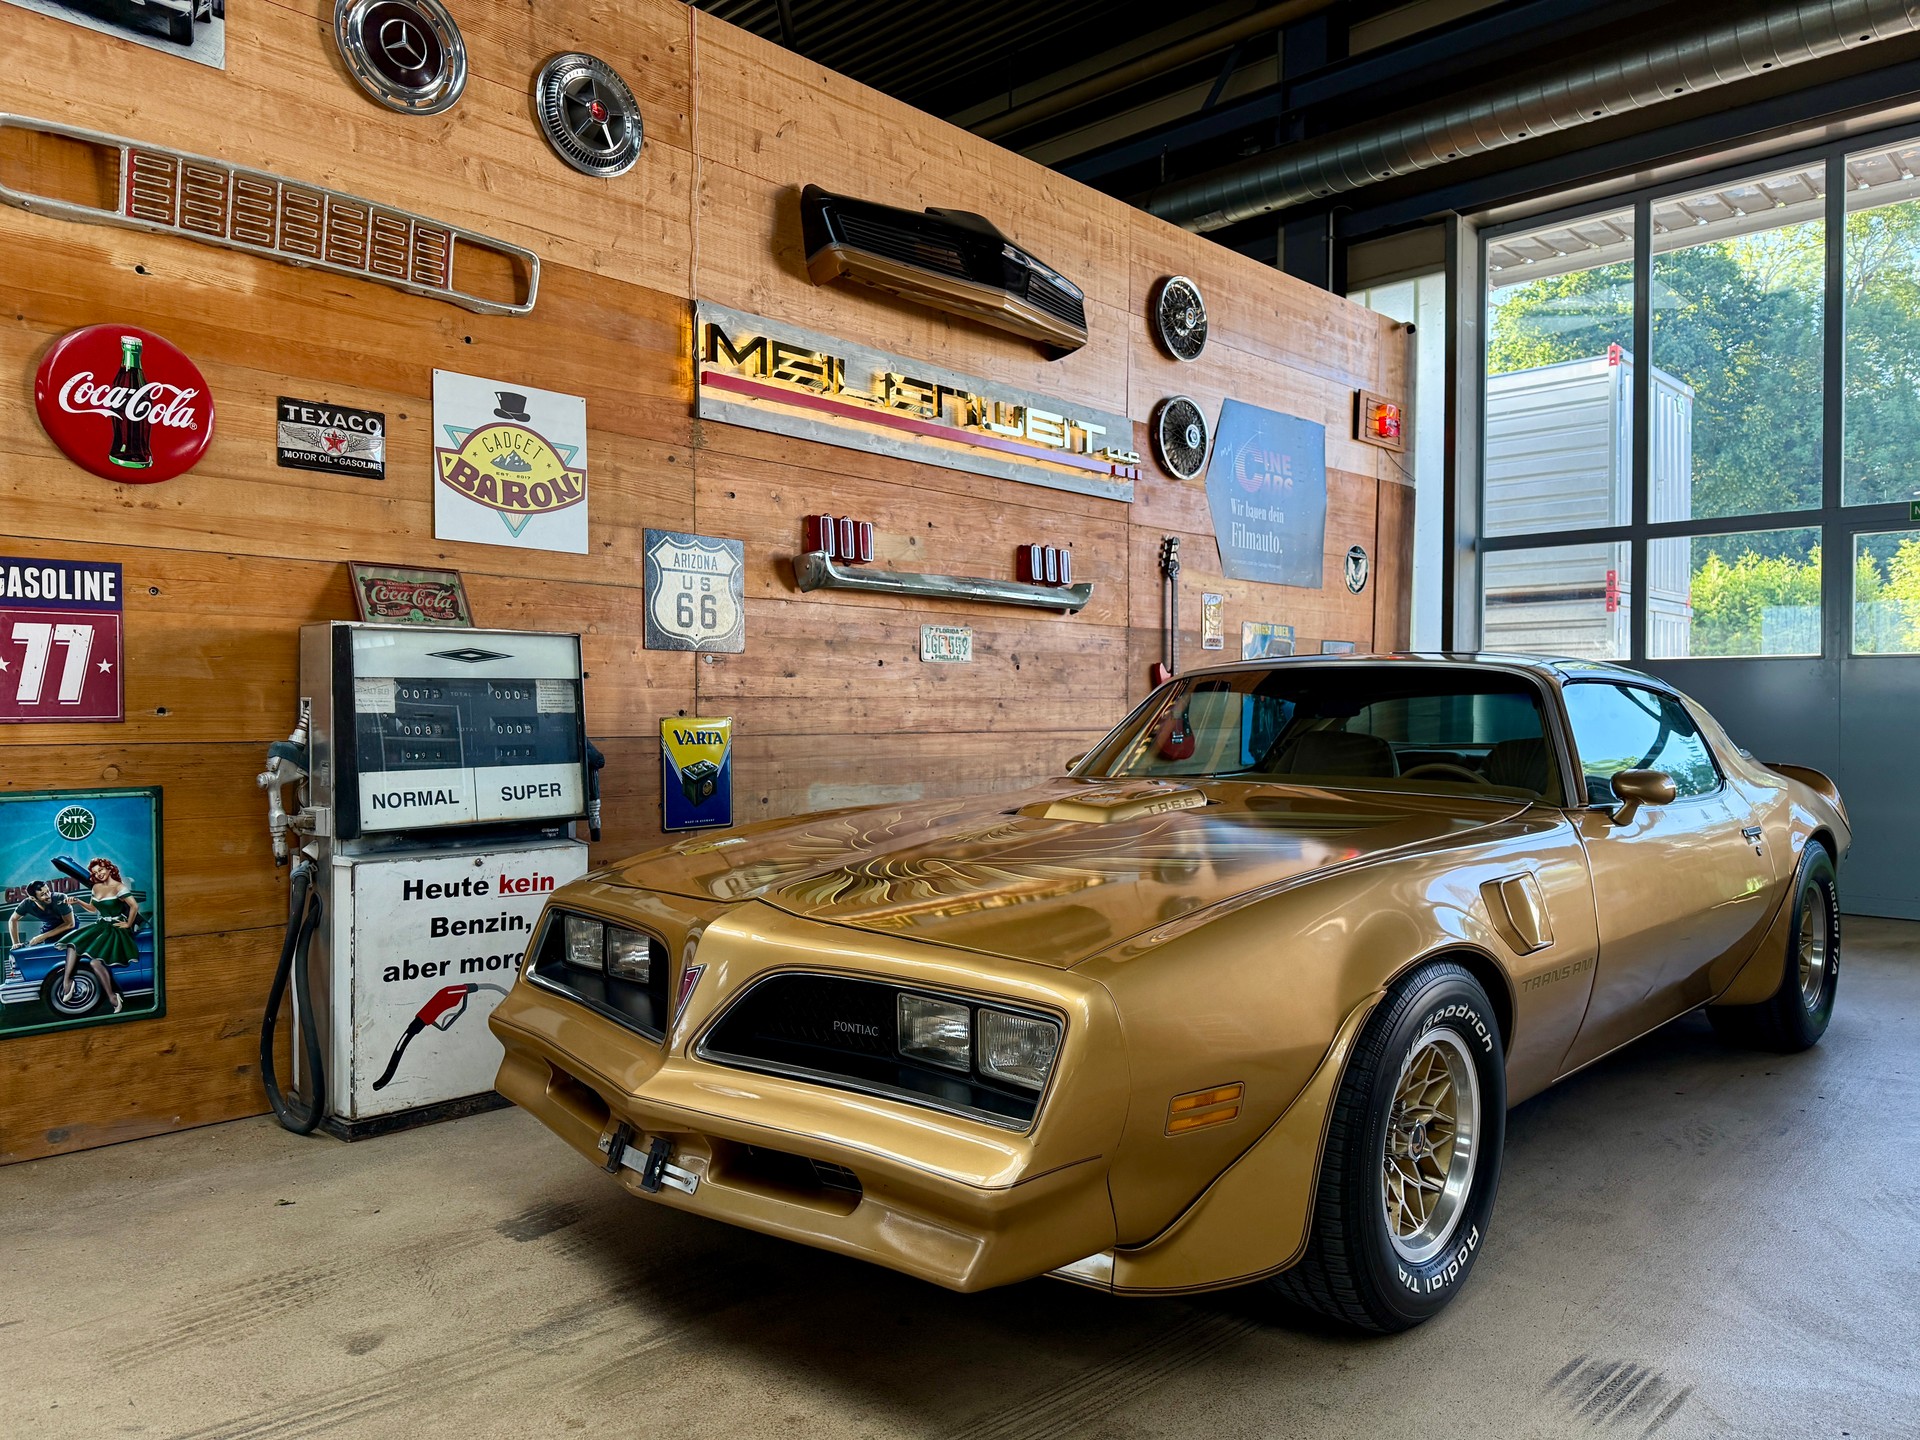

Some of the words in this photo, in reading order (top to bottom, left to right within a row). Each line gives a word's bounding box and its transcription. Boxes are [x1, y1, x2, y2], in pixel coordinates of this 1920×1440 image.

[58, 371, 199, 429] Coca-Cola
[706, 323, 1107, 454] MEILENWEIT
[283, 404, 382, 434] TEXACO
[482, 431, 544, 460] GADGET
[283, 450, 317, 462] MOTOR
[318, 454, 333, 464] OIL
[339, 458, 382, 471] GASOLINE
[446, 457, 580, 509] BARON
[1230, 498, 1244, 516] Wir
[1245, 501, 1267, 522] bauen
[1268, 505, 1285, 524] dein
[1231, 522, 1283, 554] Filmauto.
[673, 552, 718, 571] ARIZONA
[371, 585, 453, 609] Coca-Cola
[676, 592, 717, 630] 66
[935, 627, 960, 635] FLORIDA
[11, 623, 95, 705] 77
[672, 729, 724, 745] VARTA
[372, 789, 460, 809] NORMAL
[500, 782, 562, 801] SUPER
[63, 815, 88, 824] NTK
[402, 876, 490, 901] Heute
[498, 872, 555, 896] kein
[1827, 881, 1840, 938] Radial
[430, 912, 532, 938] Benzin,
[382, 959, 451, 982] aber
[460, 952, 525, 974] morg
[1521, 965, 1571, 993] TRANS
[1572, 957, 1594, 975] AM
[833, 1020, 879, 1037] PONTIAC
[1425, 1224, 1479, 1294] Radial
[1397, 1263, 1421, 1294] T/A
